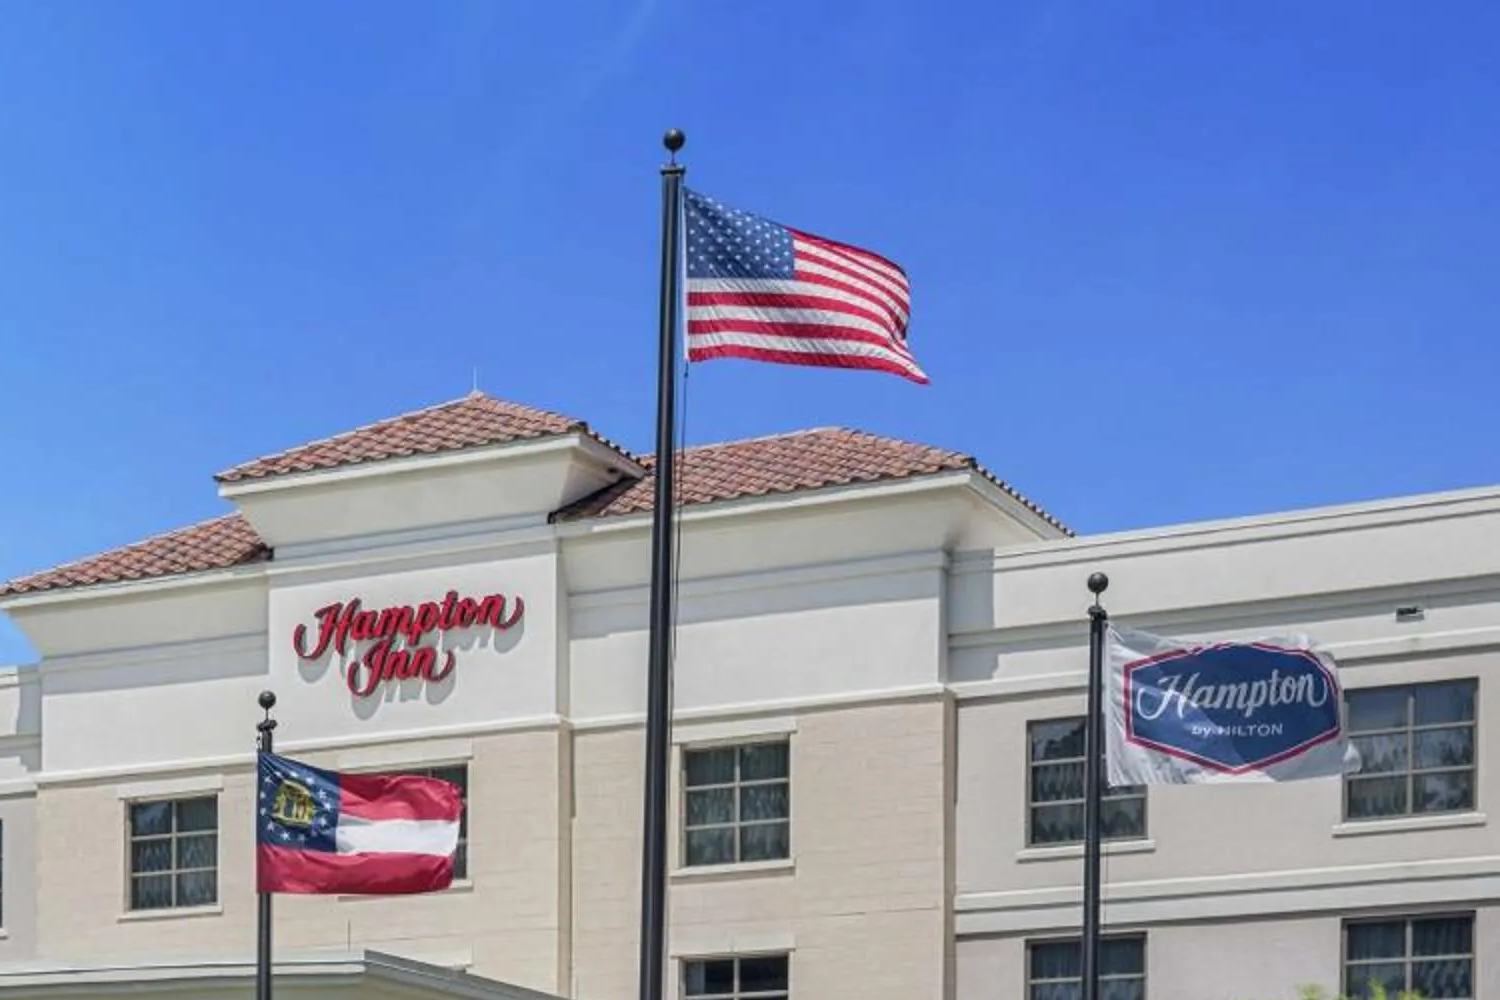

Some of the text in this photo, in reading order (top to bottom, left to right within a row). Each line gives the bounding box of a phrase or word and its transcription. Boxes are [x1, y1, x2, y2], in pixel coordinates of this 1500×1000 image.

[293, 589, 525, 661] Hampton
[347, 639, 455, 697] Inn
[1135, 668, 1328, 721] Hampton
